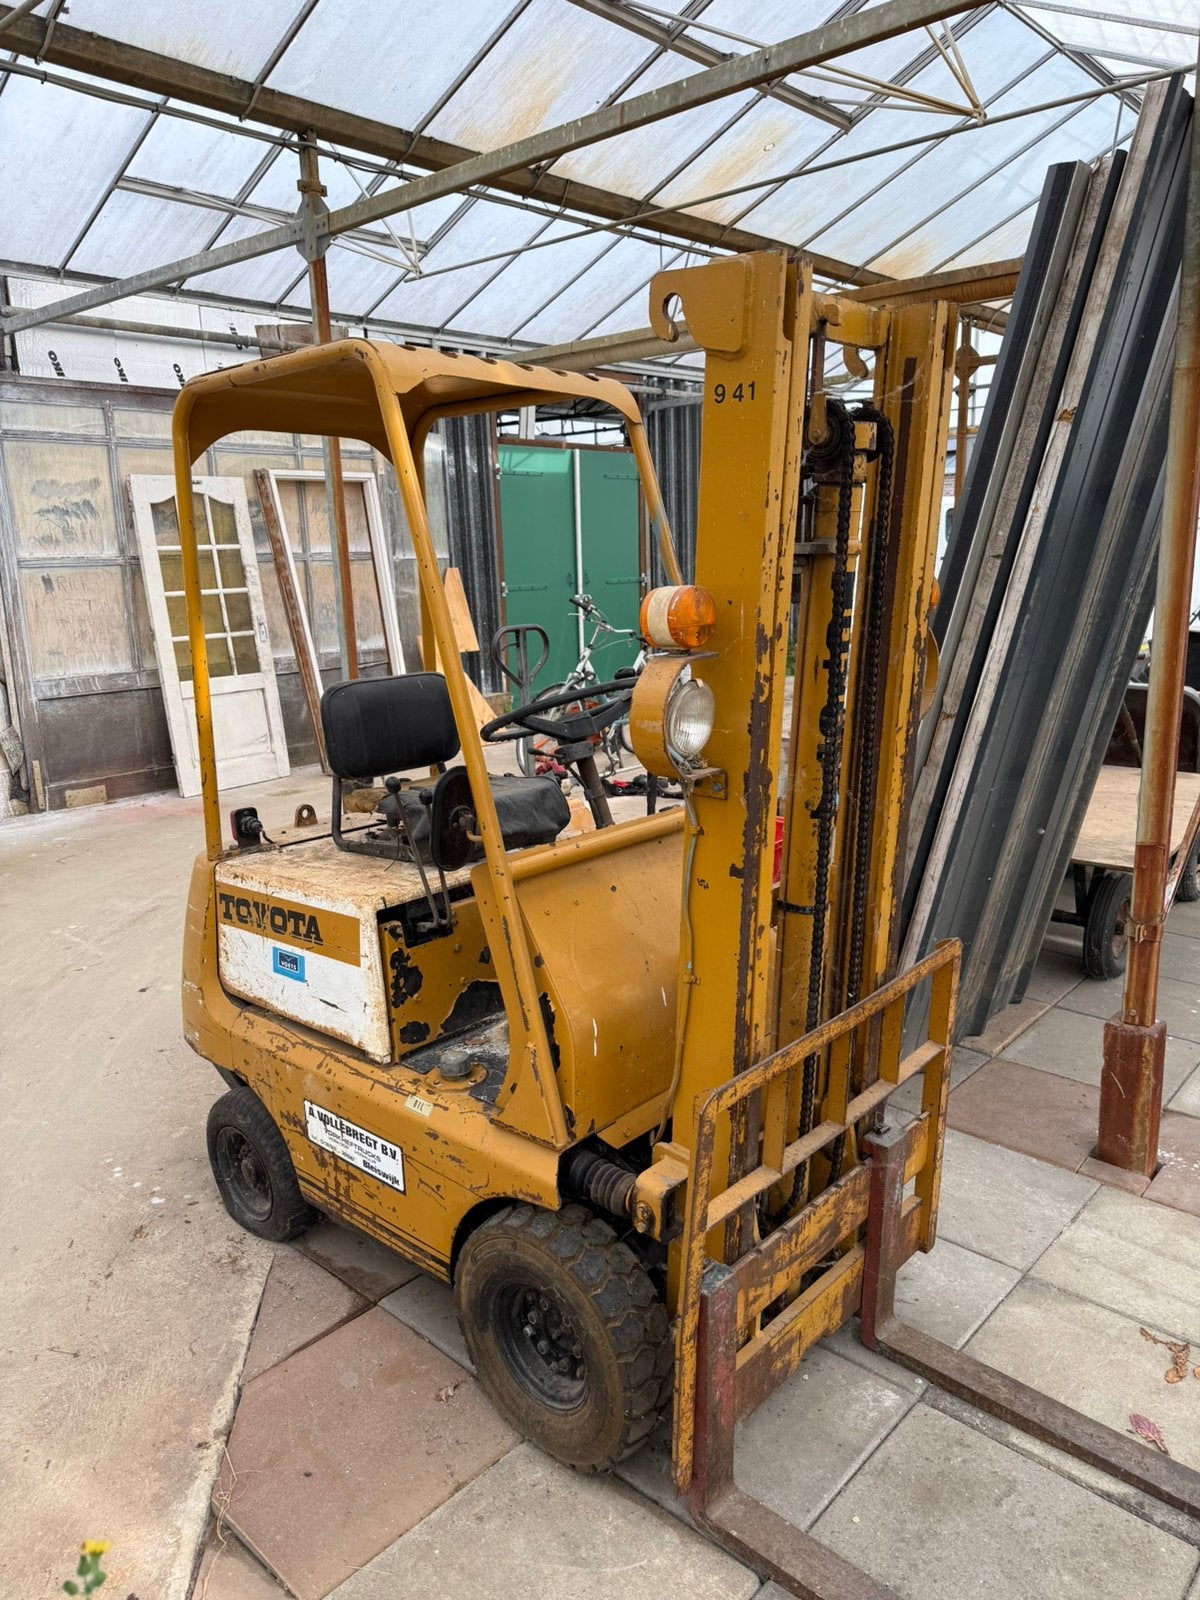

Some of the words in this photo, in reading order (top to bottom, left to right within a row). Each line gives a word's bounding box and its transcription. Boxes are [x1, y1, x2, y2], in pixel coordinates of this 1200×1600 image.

[48, 350, 66, 377] IKO
[114, 357, 129, 382] IKO
[714, 380, 756, 404] 941
[218, 892, 324, 946] TOYOTA
[317, 1110, 379, 1151] VOLLEBREGT
[381, 1143, 399, 1162] B.V.
[362, 1160, 400, 1186] Bleiswijk
